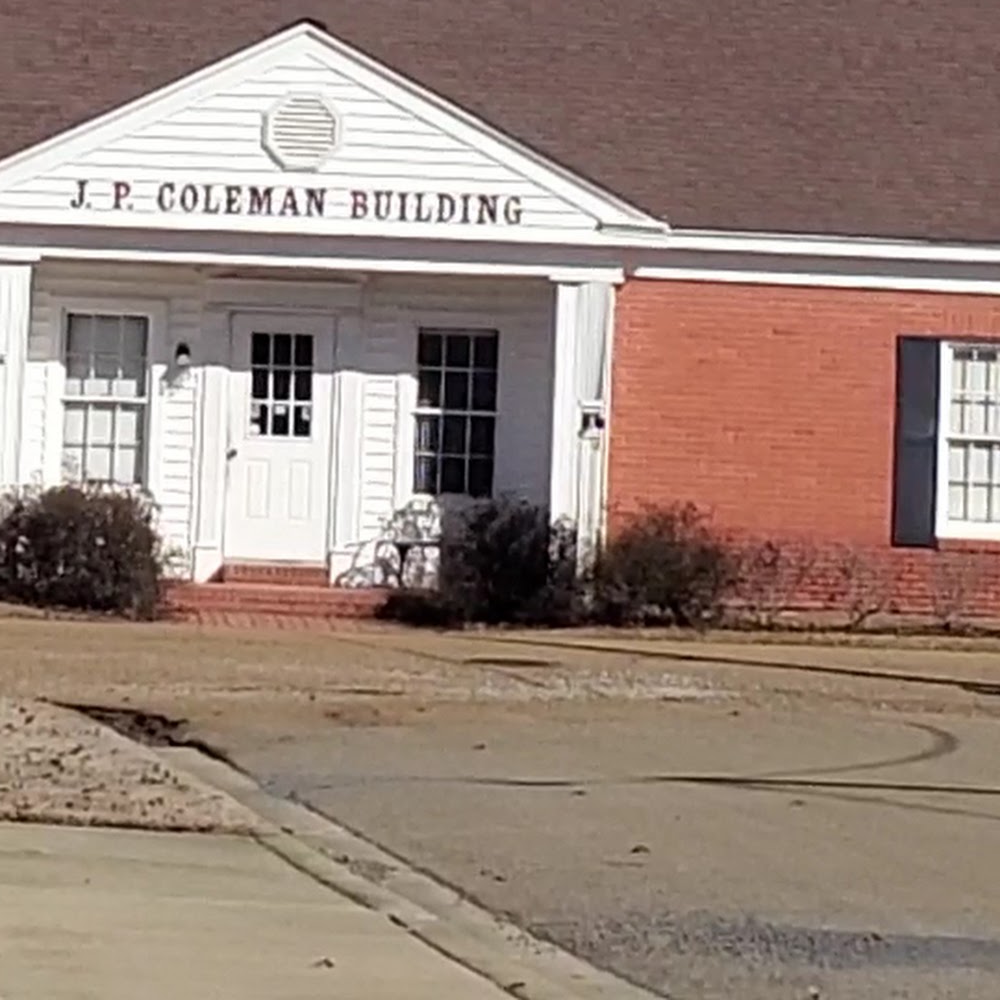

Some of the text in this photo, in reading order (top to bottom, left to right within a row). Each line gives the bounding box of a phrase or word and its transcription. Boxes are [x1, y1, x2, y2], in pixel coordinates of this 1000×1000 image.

[70, 179, 524, 225] J. P. COLEMAN BUILDING
